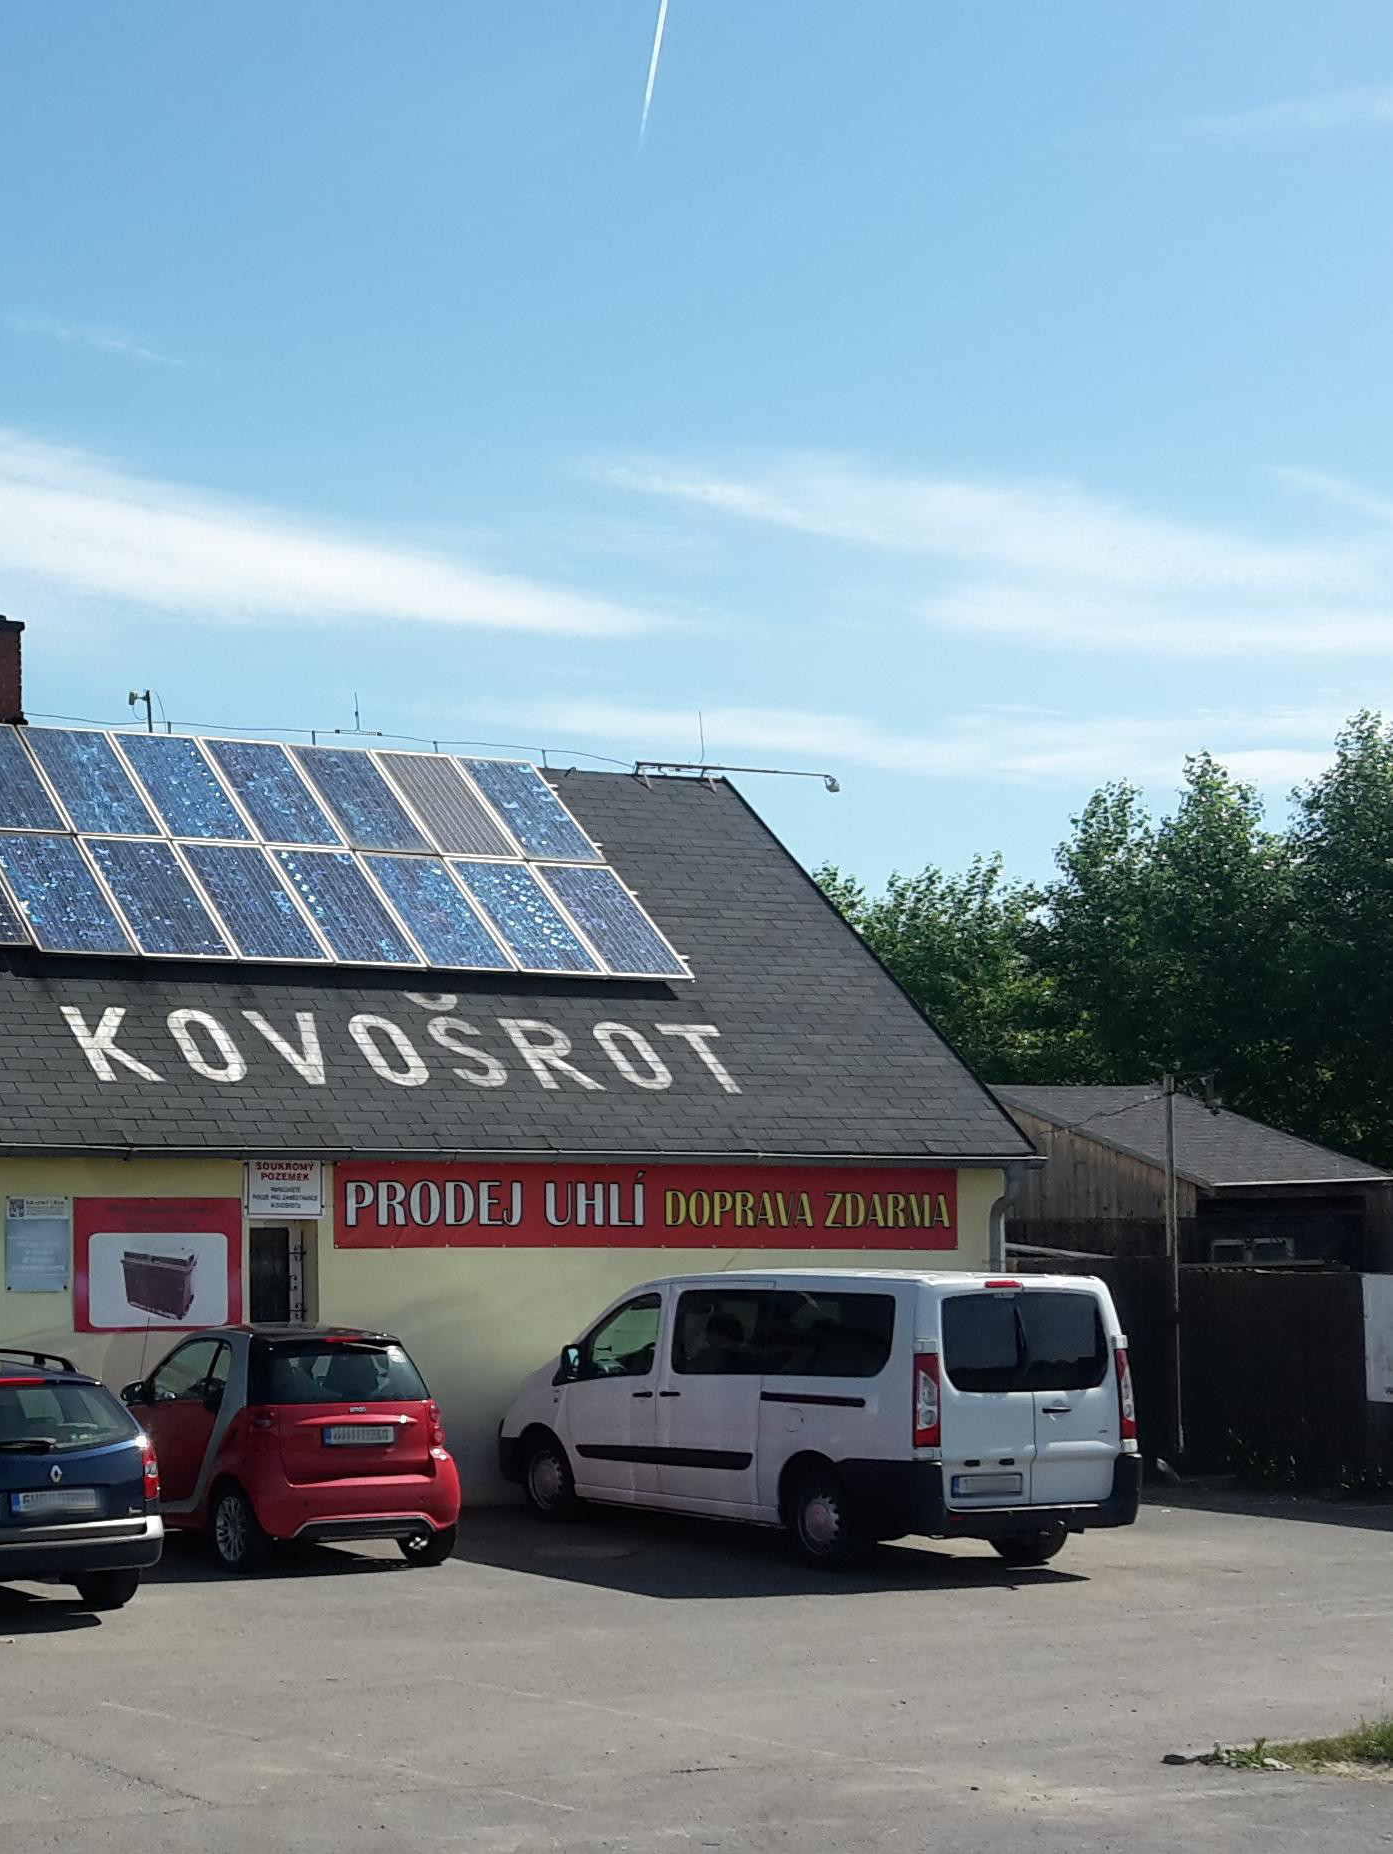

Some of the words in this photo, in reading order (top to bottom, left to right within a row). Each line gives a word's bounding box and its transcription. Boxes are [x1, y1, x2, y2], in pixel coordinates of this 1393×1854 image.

[59, 992, 744, 1095] KOVOŠROT
[260, 1172, 310, 1181] POZEMEK
[345, 1180, 523, 1226] PRODEJ
[544, 1171, 646, 1226] UHLÍ
[664, 1190, 814, 1227] DOPRAVA
[824, 1192, 951, 1228] ZDARMA
